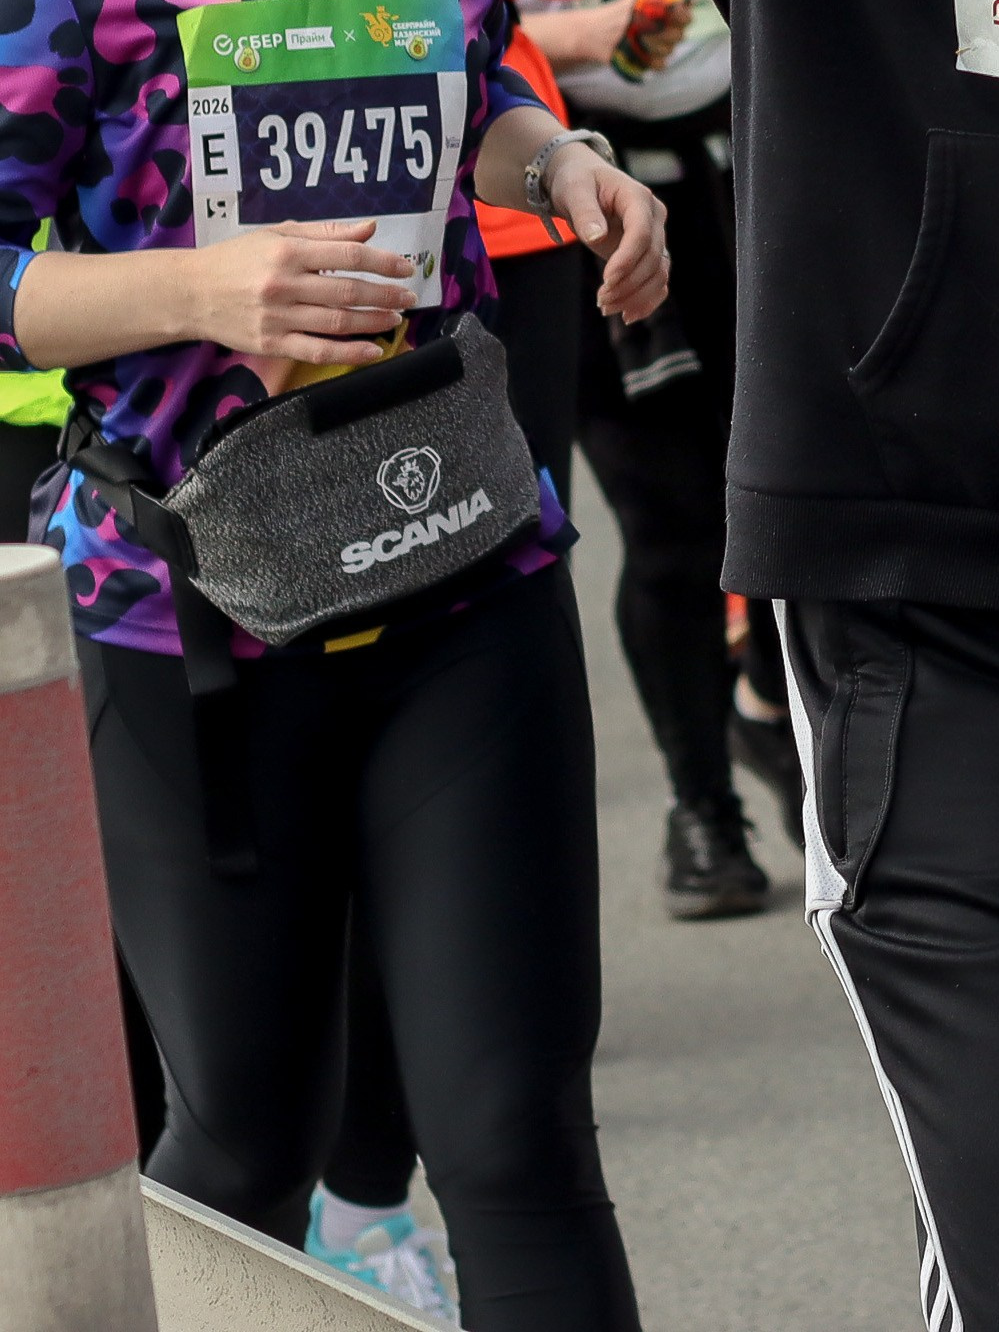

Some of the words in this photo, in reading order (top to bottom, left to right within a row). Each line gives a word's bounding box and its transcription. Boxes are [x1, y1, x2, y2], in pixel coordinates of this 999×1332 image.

[291, 32, 326, 46] Прайм
[192, 98, 229, 116] 2026
[257, 105, 434, 191] 39475
[340, 488, 494, 574] SCANIA
